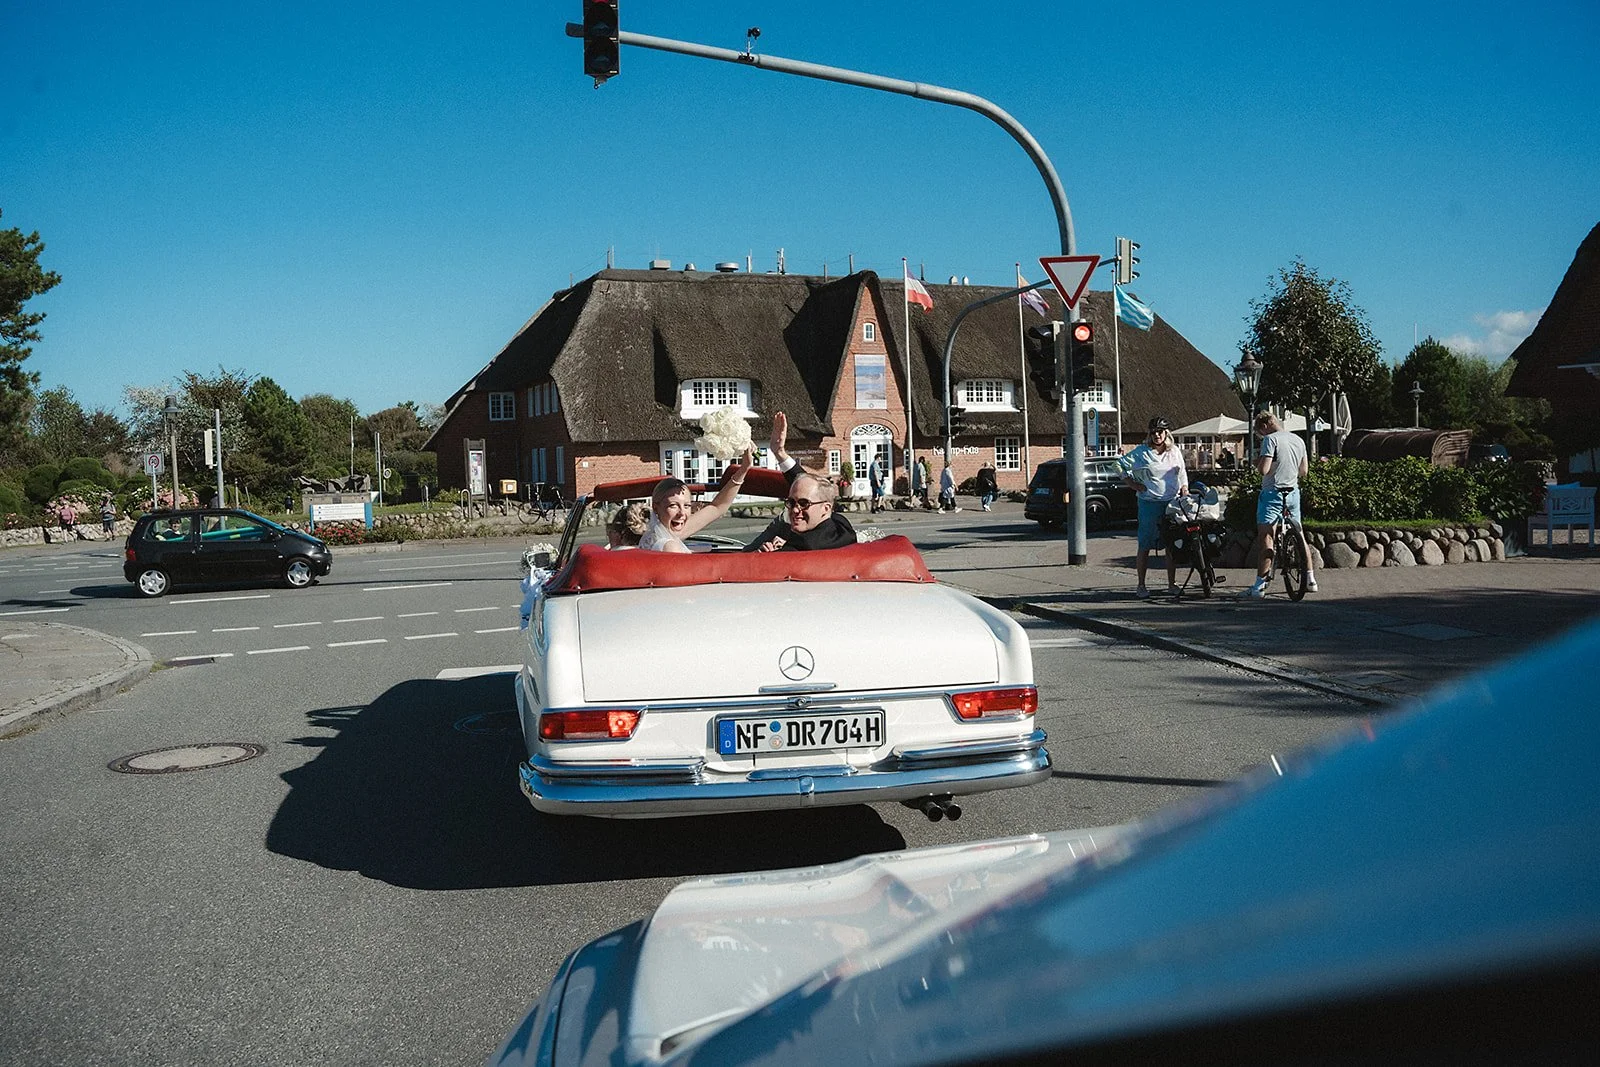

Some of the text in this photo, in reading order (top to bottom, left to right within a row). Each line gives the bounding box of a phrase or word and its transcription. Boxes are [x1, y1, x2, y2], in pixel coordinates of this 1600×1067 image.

[736, 717, 880, 749] NF DR704H
[724, 740, 731, 749] D
